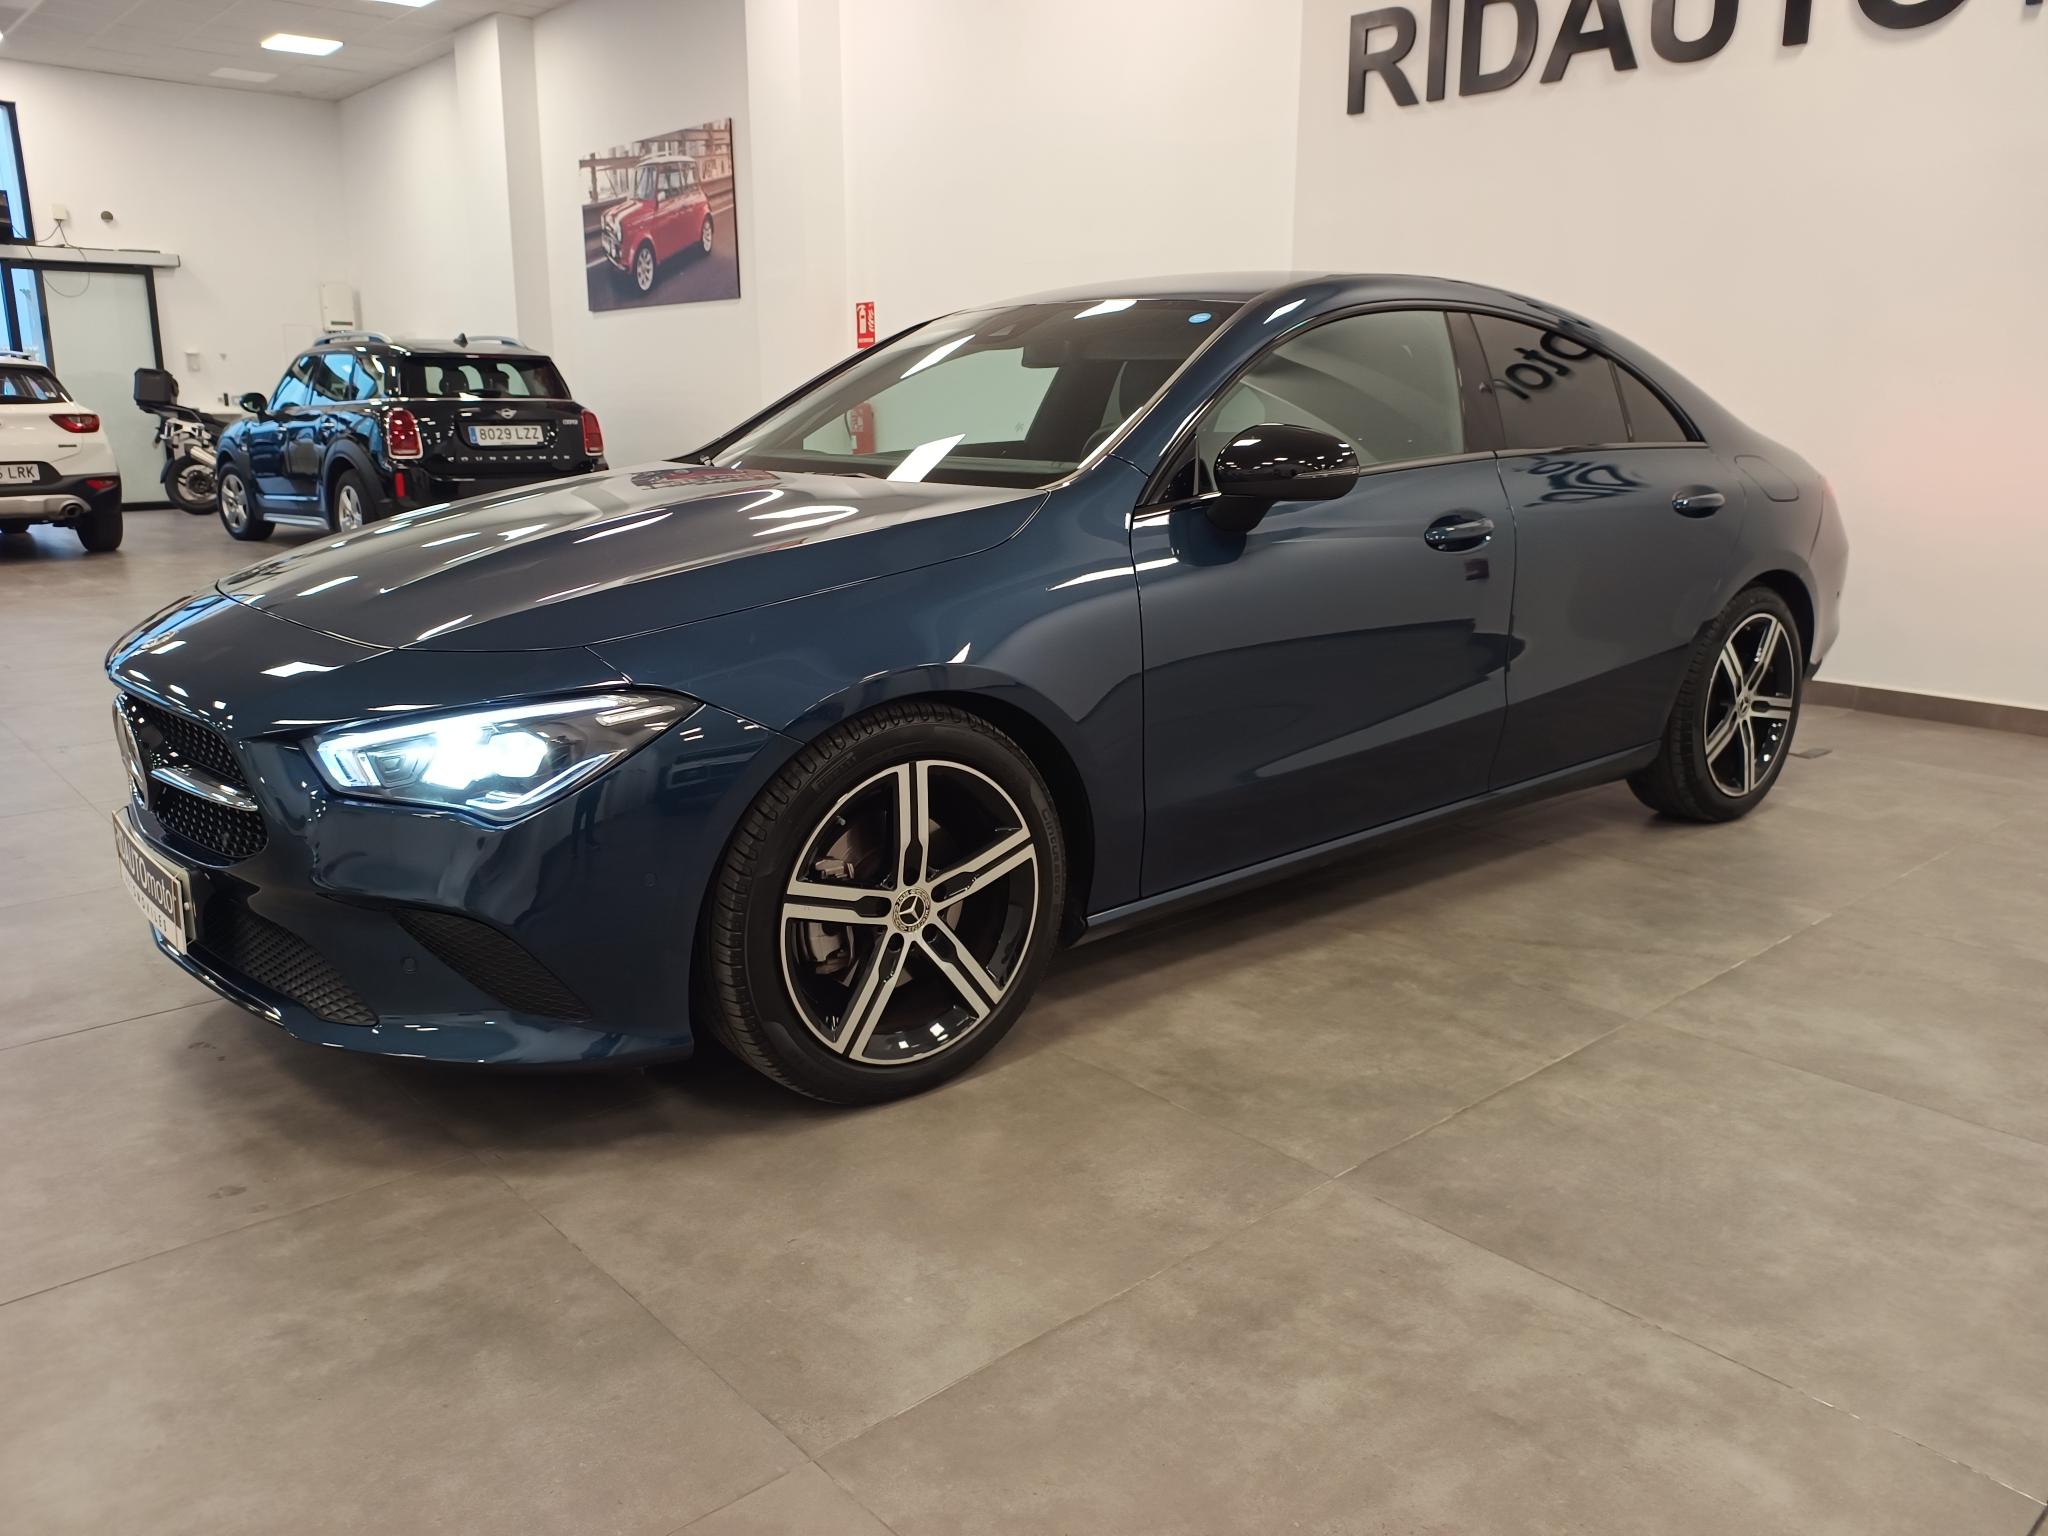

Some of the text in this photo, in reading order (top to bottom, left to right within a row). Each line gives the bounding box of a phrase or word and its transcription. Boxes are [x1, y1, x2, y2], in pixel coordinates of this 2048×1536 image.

[1347, 0, 2043, 115] RIDAU
[480, 427, 540, 441] 8029 LZZ
[7, 466, 35, 480] LRK
